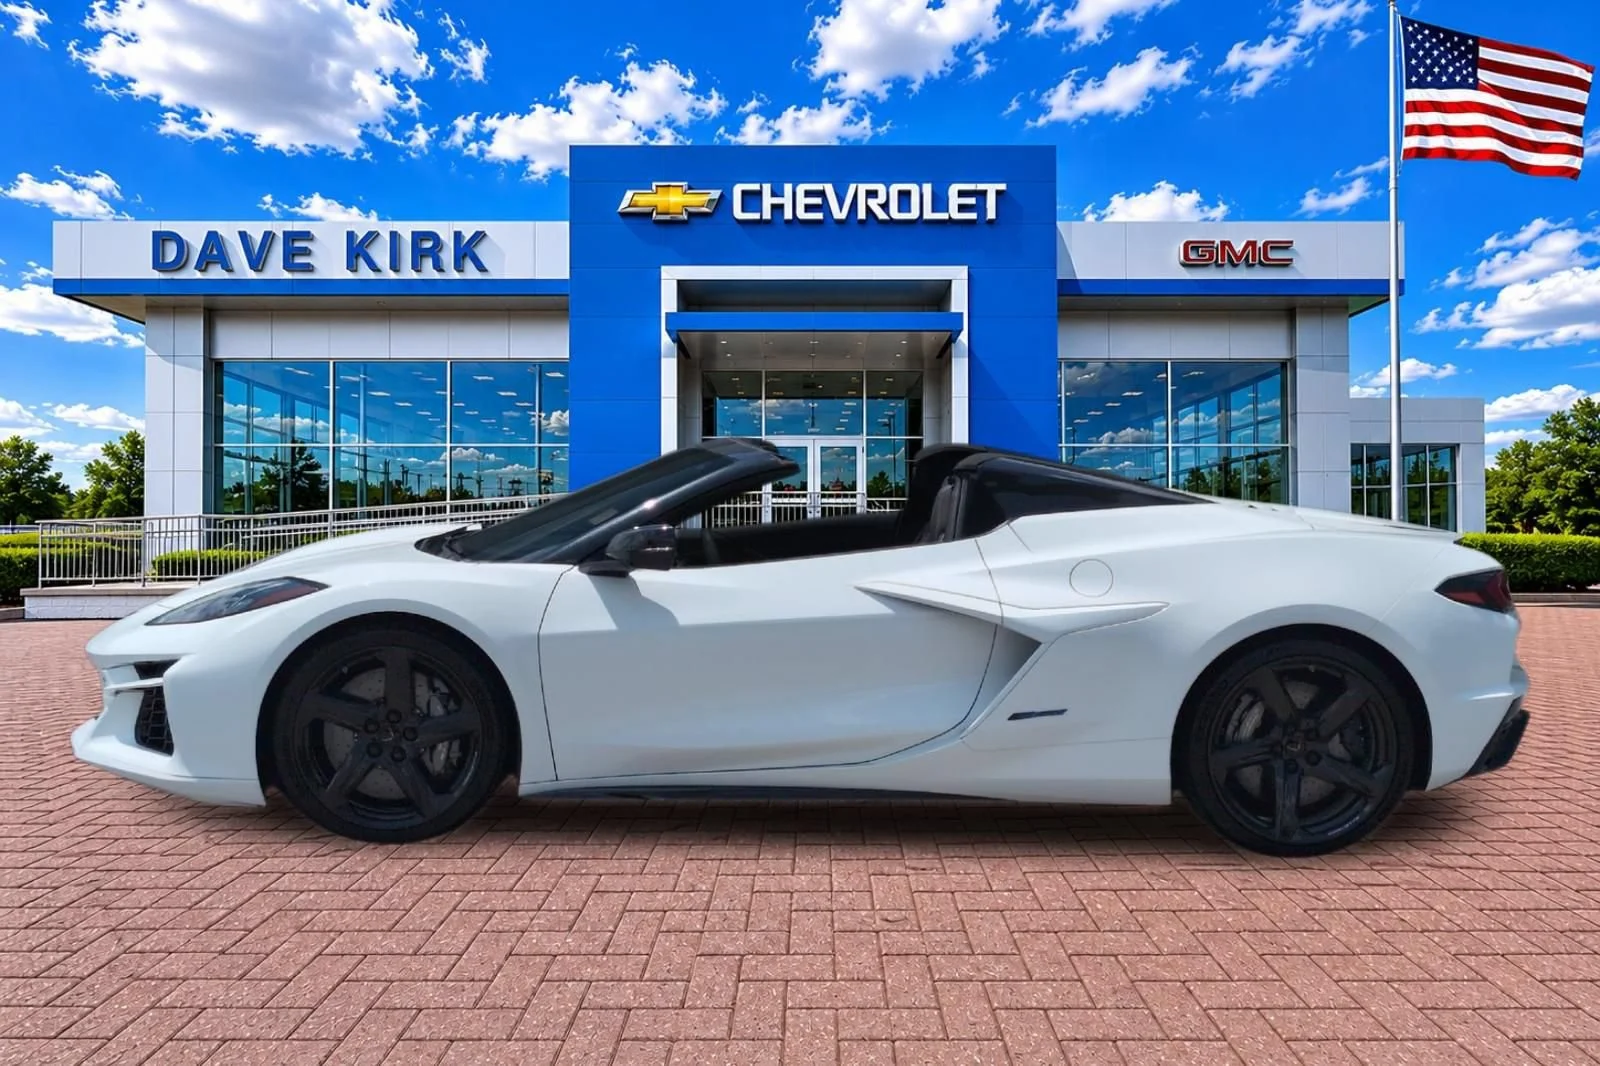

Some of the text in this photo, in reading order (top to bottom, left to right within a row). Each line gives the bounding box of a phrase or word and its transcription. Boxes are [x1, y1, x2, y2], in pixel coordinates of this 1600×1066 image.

[732, 183, 1007, 221] CHEVROLET
[151, 230, 490, 272] DAVE KIRK
[1179, 239, 1294, 267] GMC
